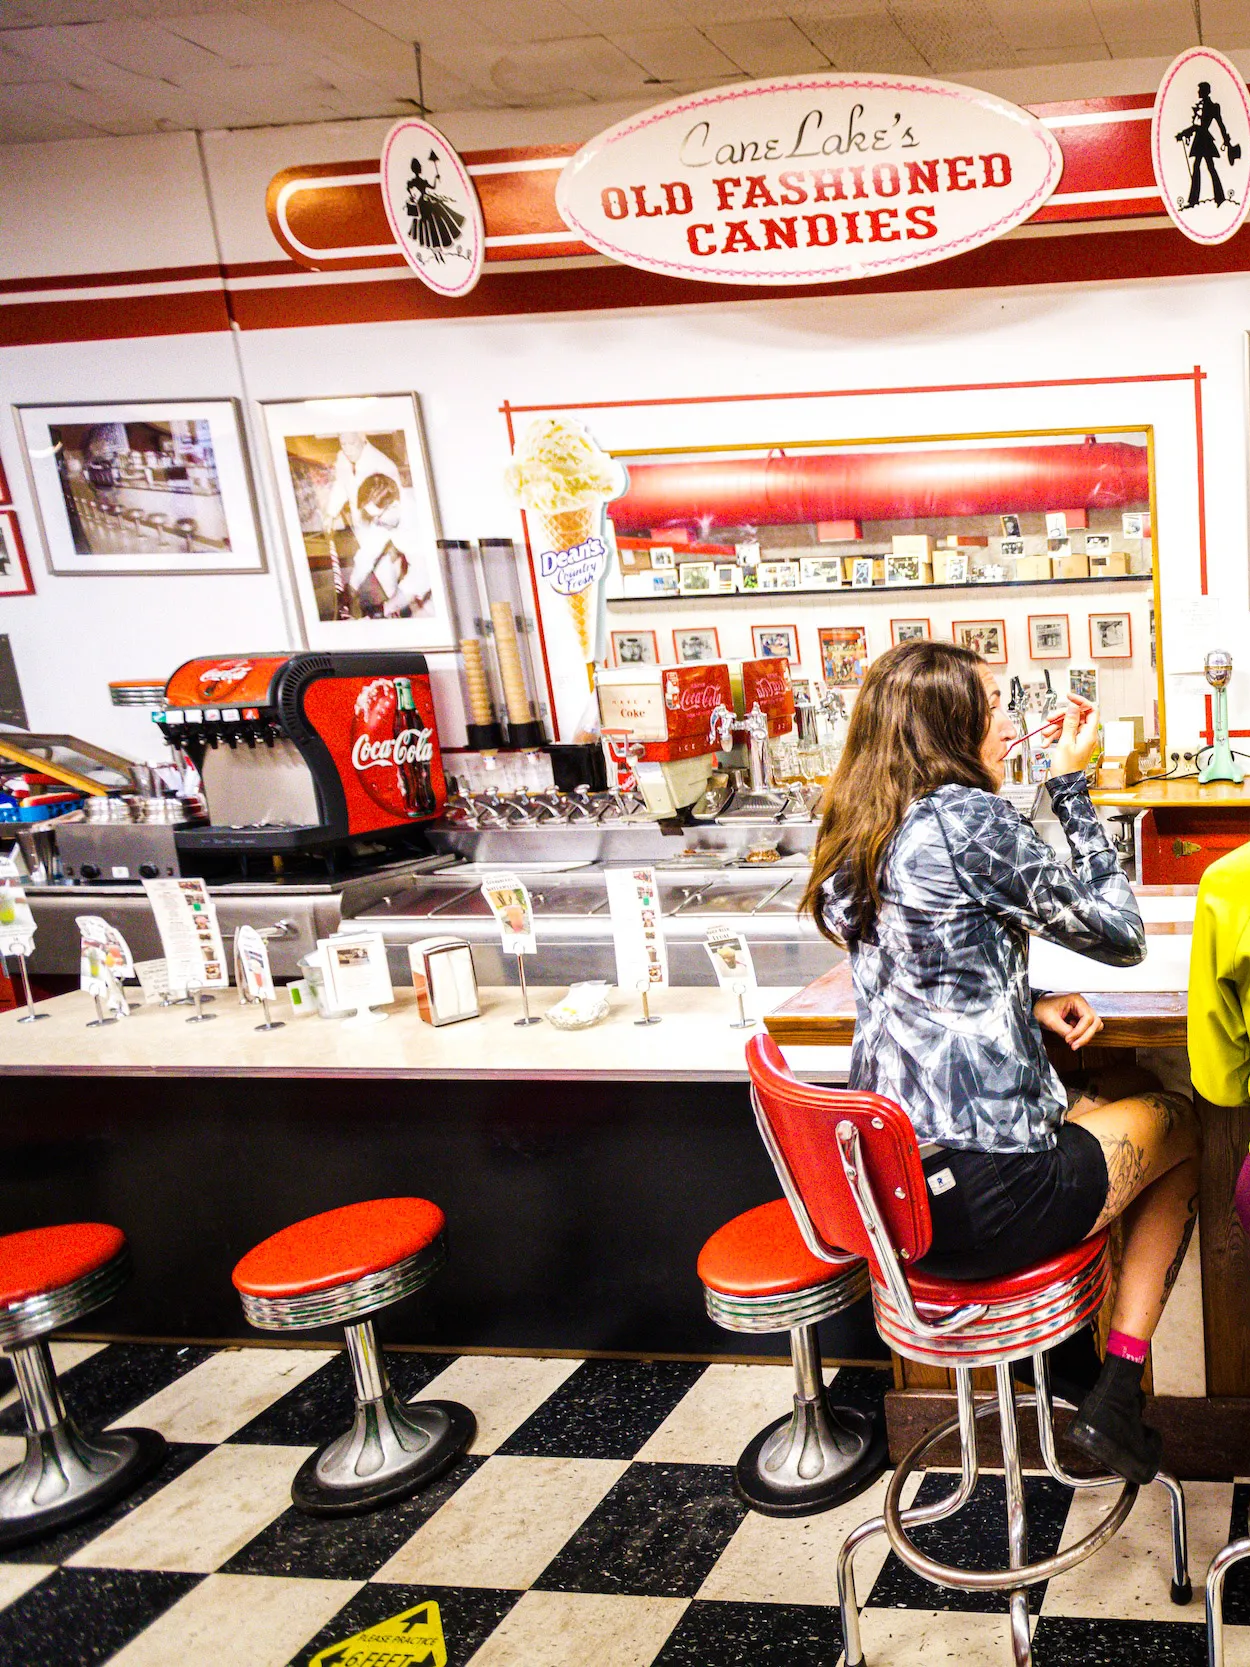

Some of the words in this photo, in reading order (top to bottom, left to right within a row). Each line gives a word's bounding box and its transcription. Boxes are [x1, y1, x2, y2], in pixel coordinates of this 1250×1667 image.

[601, 182, 694, 221] OLD
[712, 152, 1013, 212] FASHIONED
[686, 205, 939, 257] CANDIES
[540, 537, 605, 577] Dean's
[557, 562, 597, 585] Country
[620, 709, 646, 718] Coke
[352, 727, 433, 771] Coca-Cola
[358, 1633, 393, 1644] PLEASE
[393, 1635, 438, 1646] PRACTICE
[359, 1652, 415, 1667] FEET
